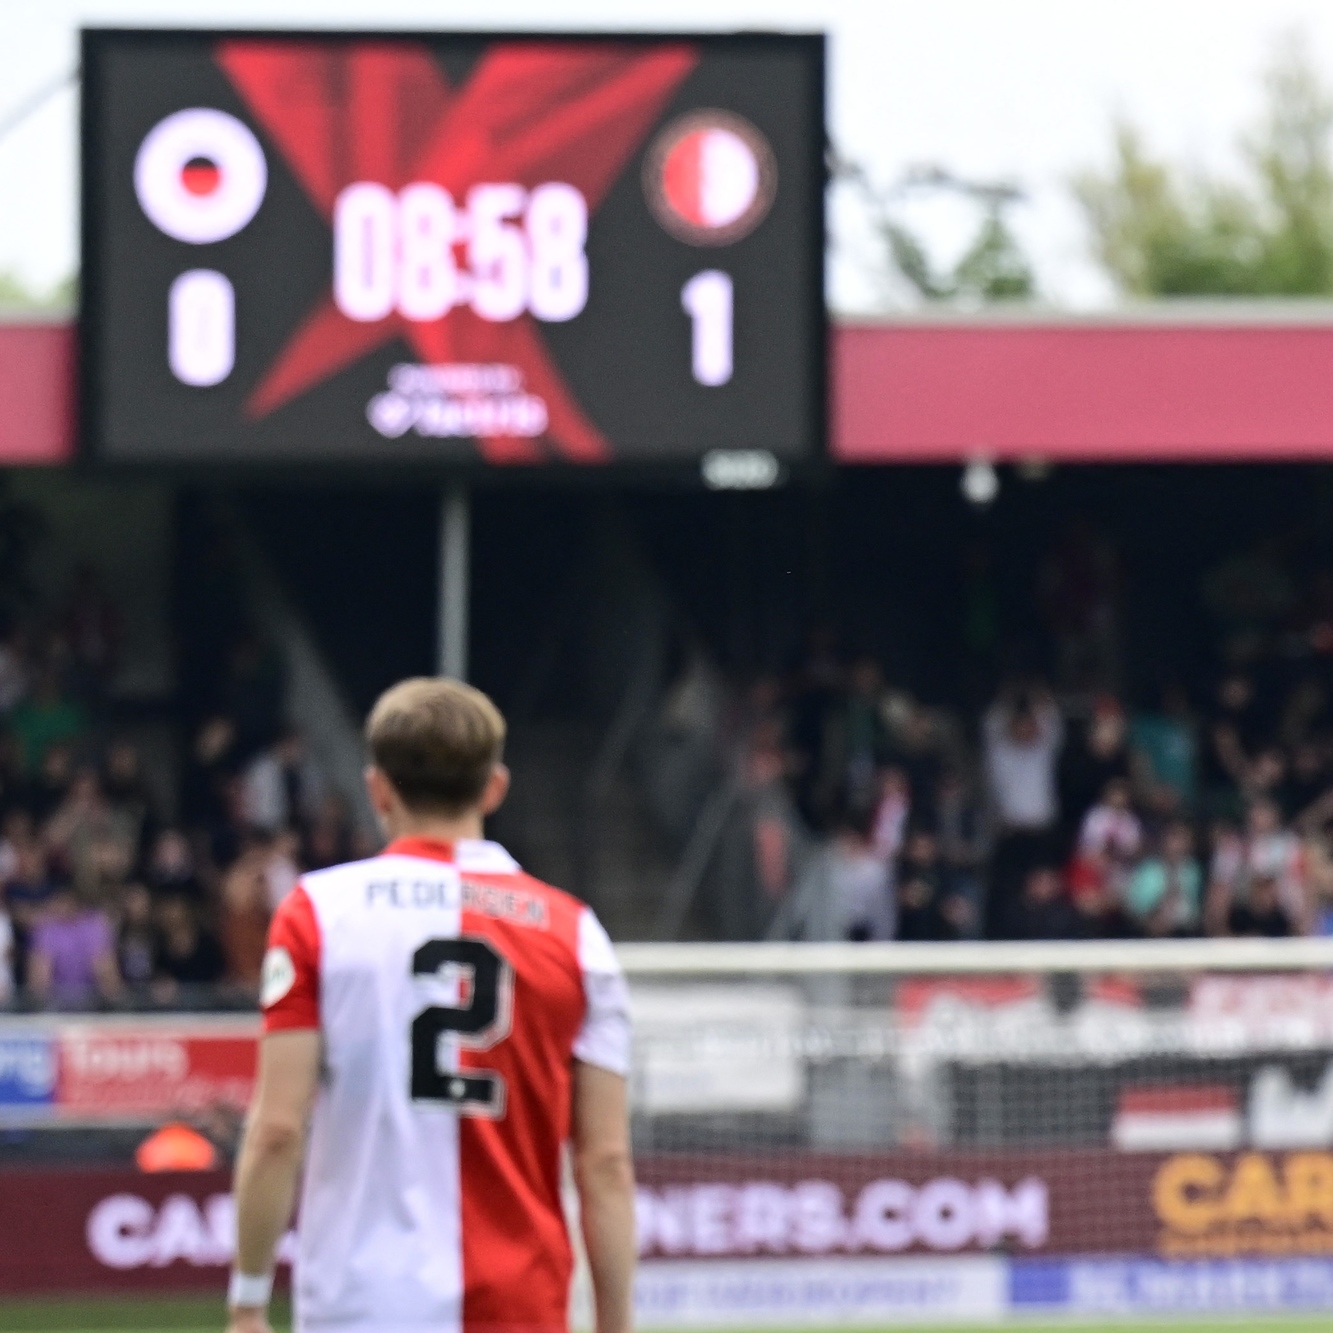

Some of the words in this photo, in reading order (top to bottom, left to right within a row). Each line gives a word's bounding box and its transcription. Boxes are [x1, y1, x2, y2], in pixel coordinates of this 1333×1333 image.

[334, 181, 588, 322] 08:58
[168, 268, 236, 387] 0
[681, 269, 734, 387] 1
[410, 937, 517, 1120] 2
